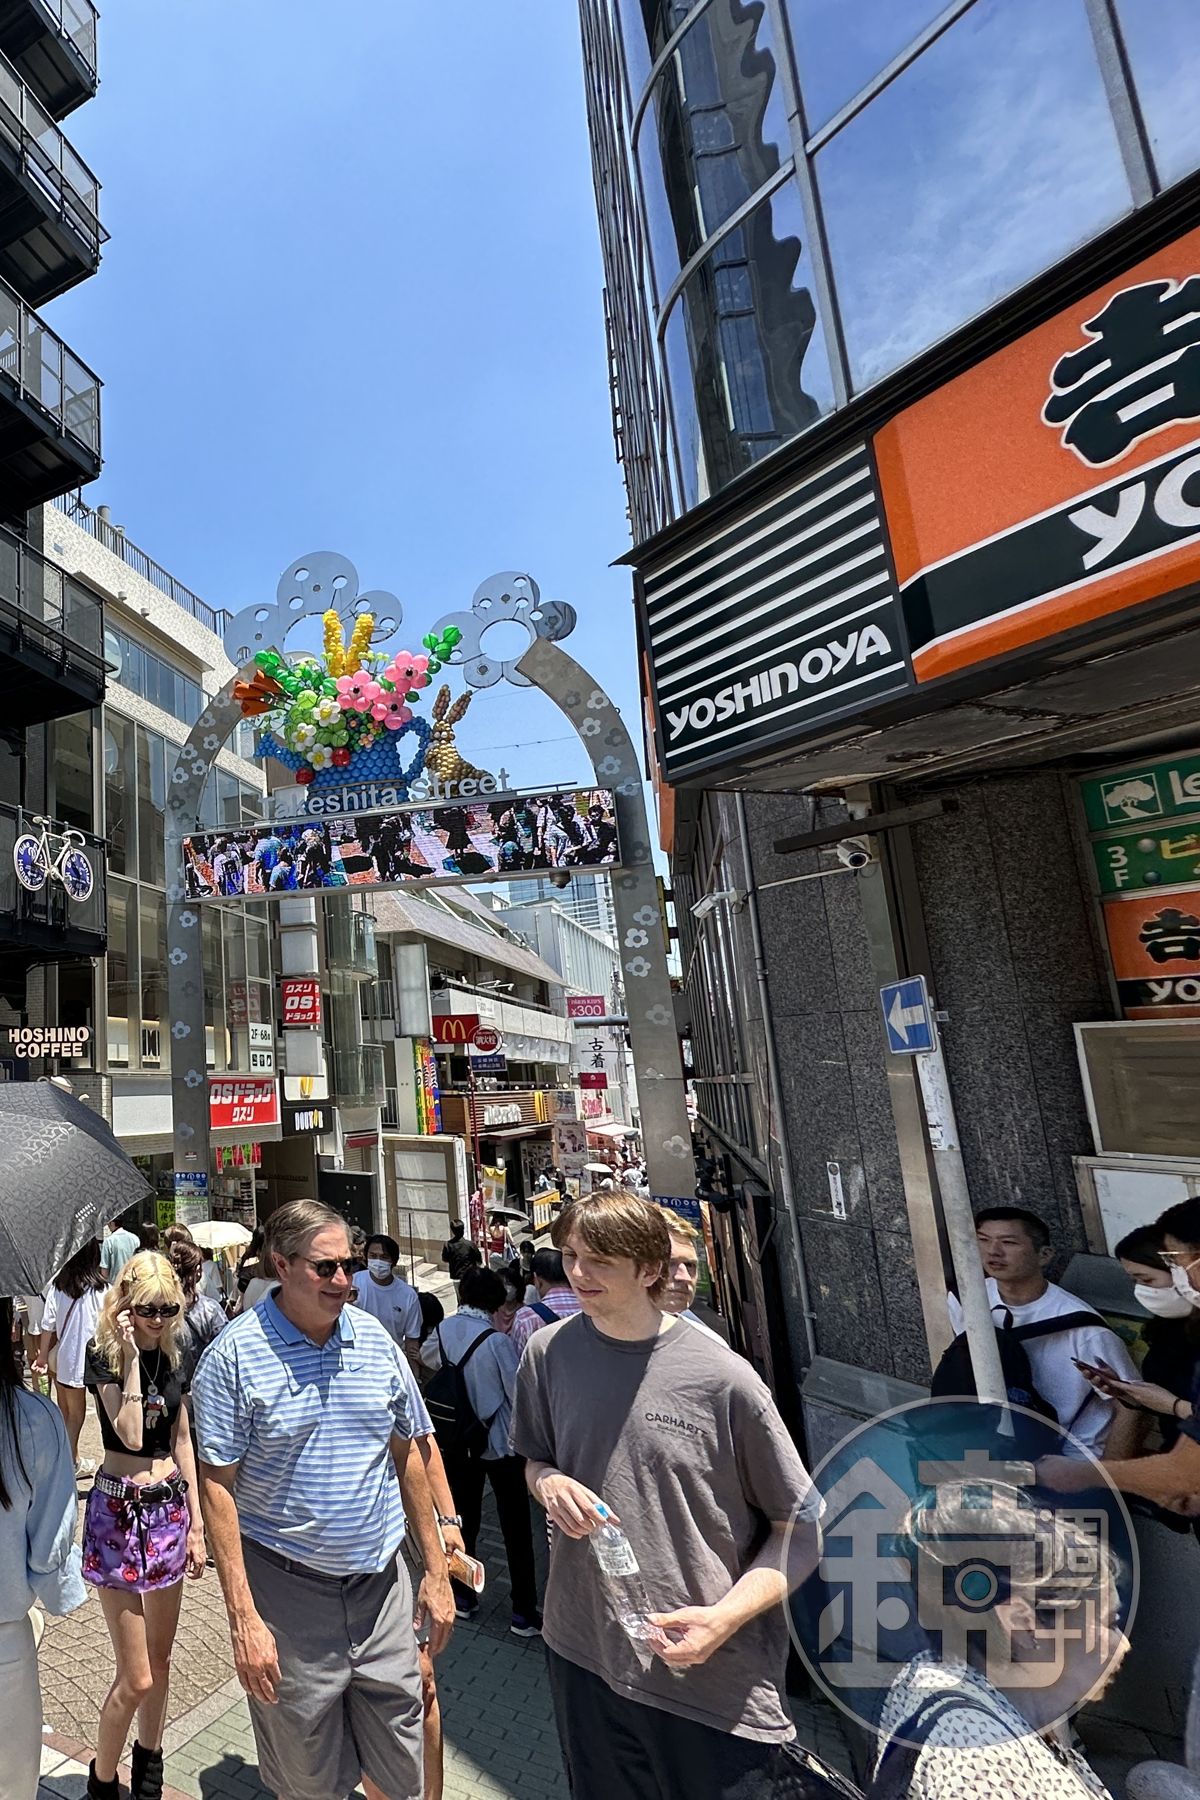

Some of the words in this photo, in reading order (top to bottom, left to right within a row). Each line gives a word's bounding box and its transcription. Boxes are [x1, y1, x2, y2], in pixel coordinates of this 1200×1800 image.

[667, 624, 891, 741] YOSHINOYA
[258, 778, 398, 820] Takeshita
[410, 767, 512, 801] Street
[1138, 906, 1200, 966] 吉
[285, 983, 313, 993] クスリ
[285, 996, 314, 1010] OS
[571, 1005, 602, 1017] ¥300
[285, 1012, 314, 1020] ドラッグ
[8, 1026, 90, 1044] HOSHINO
[251, 1029, 258, 1040] 2F
[15, 1042, 83, 1058] COFFEE
[589, 1037, 605, 1069] 古着
[210, 1083, 273, 1105] OSドラッグ
[232, 1106, 254, 1122] クスリ
[295, 1108, 324, 1131] DOUTOR
[645, 1412, 709, 1438] CARHARTT
